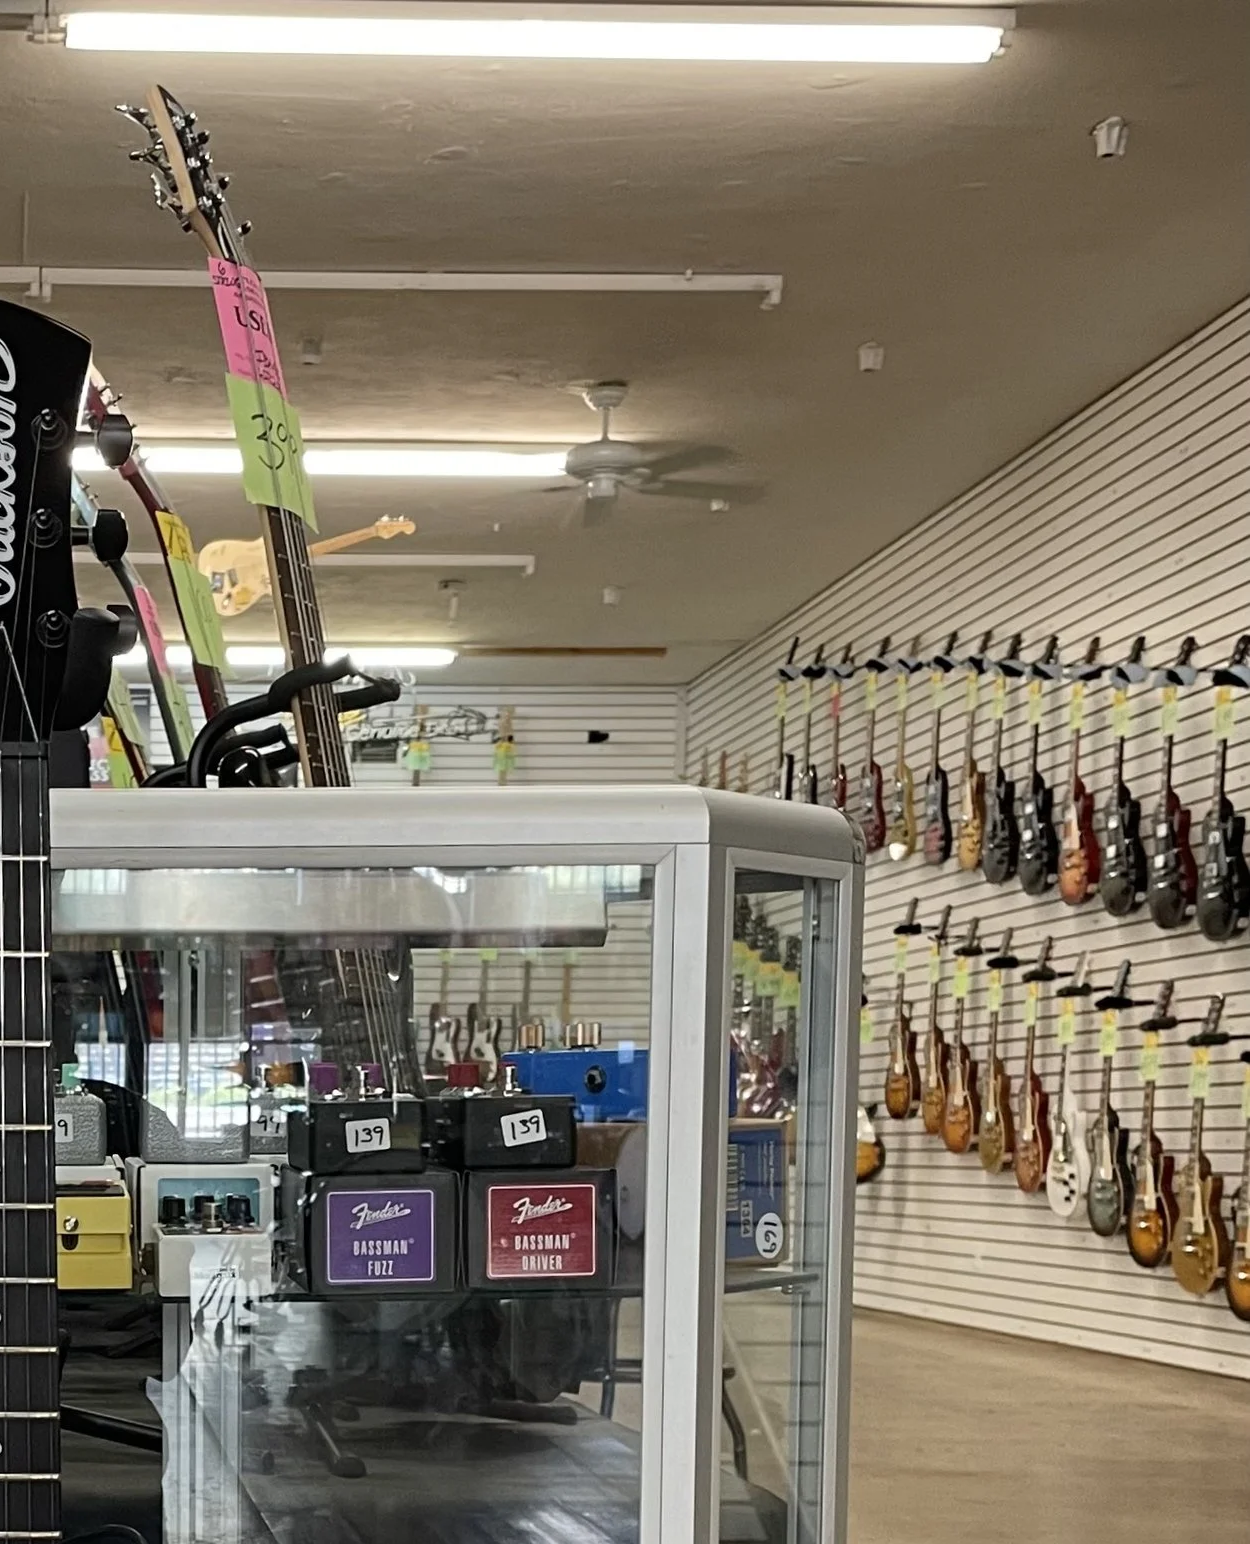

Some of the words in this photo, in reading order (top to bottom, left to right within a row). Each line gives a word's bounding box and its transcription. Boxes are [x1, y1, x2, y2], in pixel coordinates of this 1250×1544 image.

[354, 1126, 384, 1147] 139
[509, 1115, 540, 1141] 139
[350, 1200, 412, 1230] Fender
[511, 1194, 574, 1225] Fender
[353, 1239, 408, 1256] BASSMAN
[514, 1234, 570, 1251] BASSMAN
[762, 1221, 778, 1254] 169
[367, 1260, 394, 1277] FUZZ
[521, 1255, 563, 1271] DRIVER
